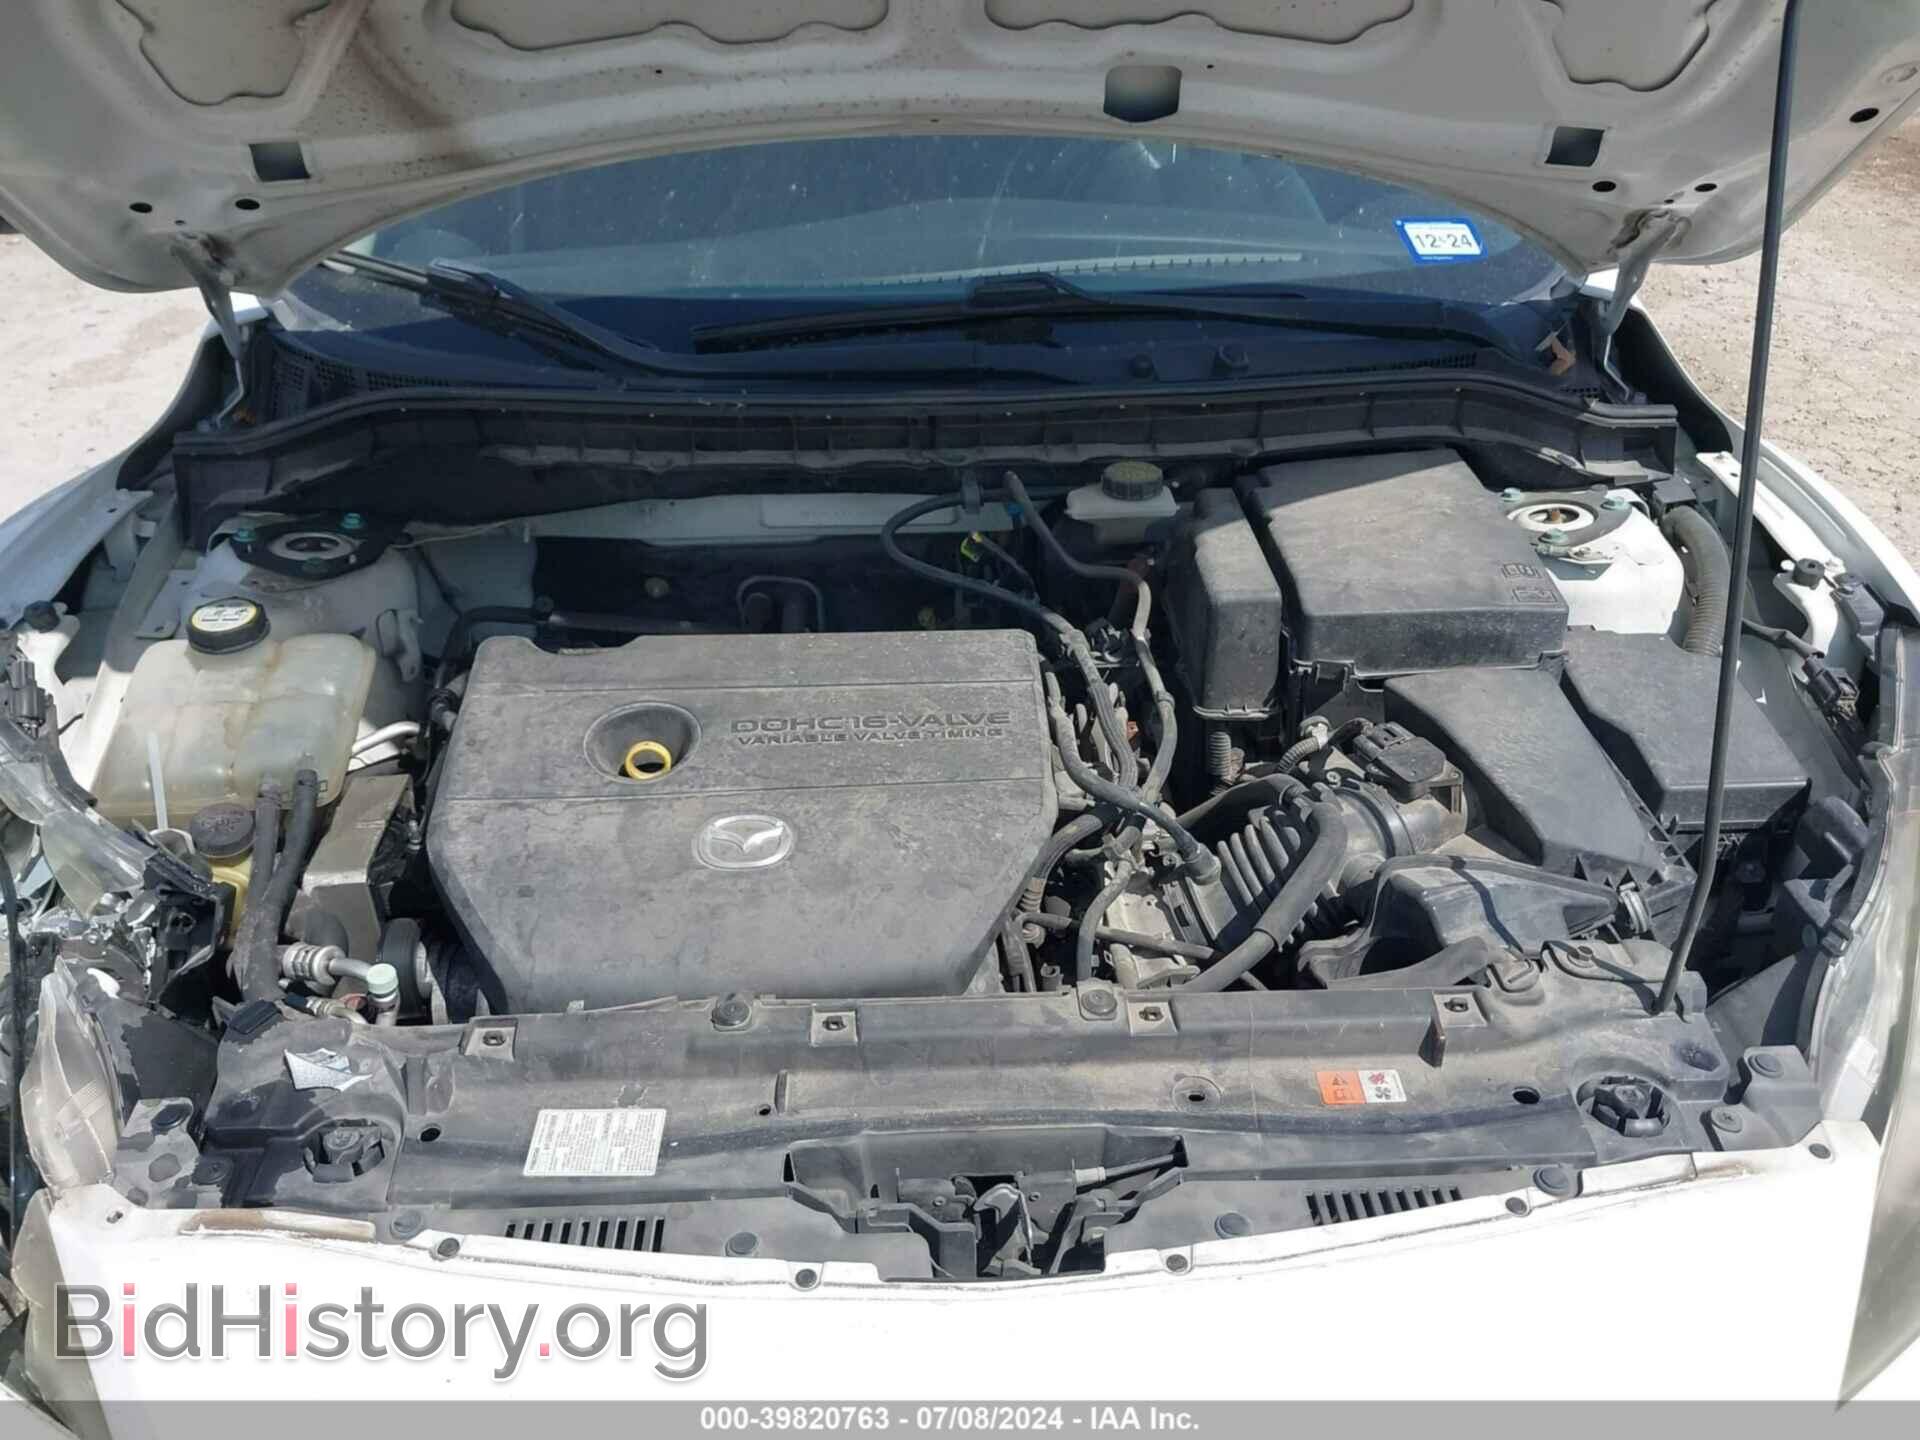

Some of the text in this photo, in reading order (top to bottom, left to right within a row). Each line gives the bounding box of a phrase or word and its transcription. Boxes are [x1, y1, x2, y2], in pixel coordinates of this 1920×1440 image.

[731, 717, 846, 732] DOHC
[737, 728, 1003, 744] VARIABLE VALVE TIMING
